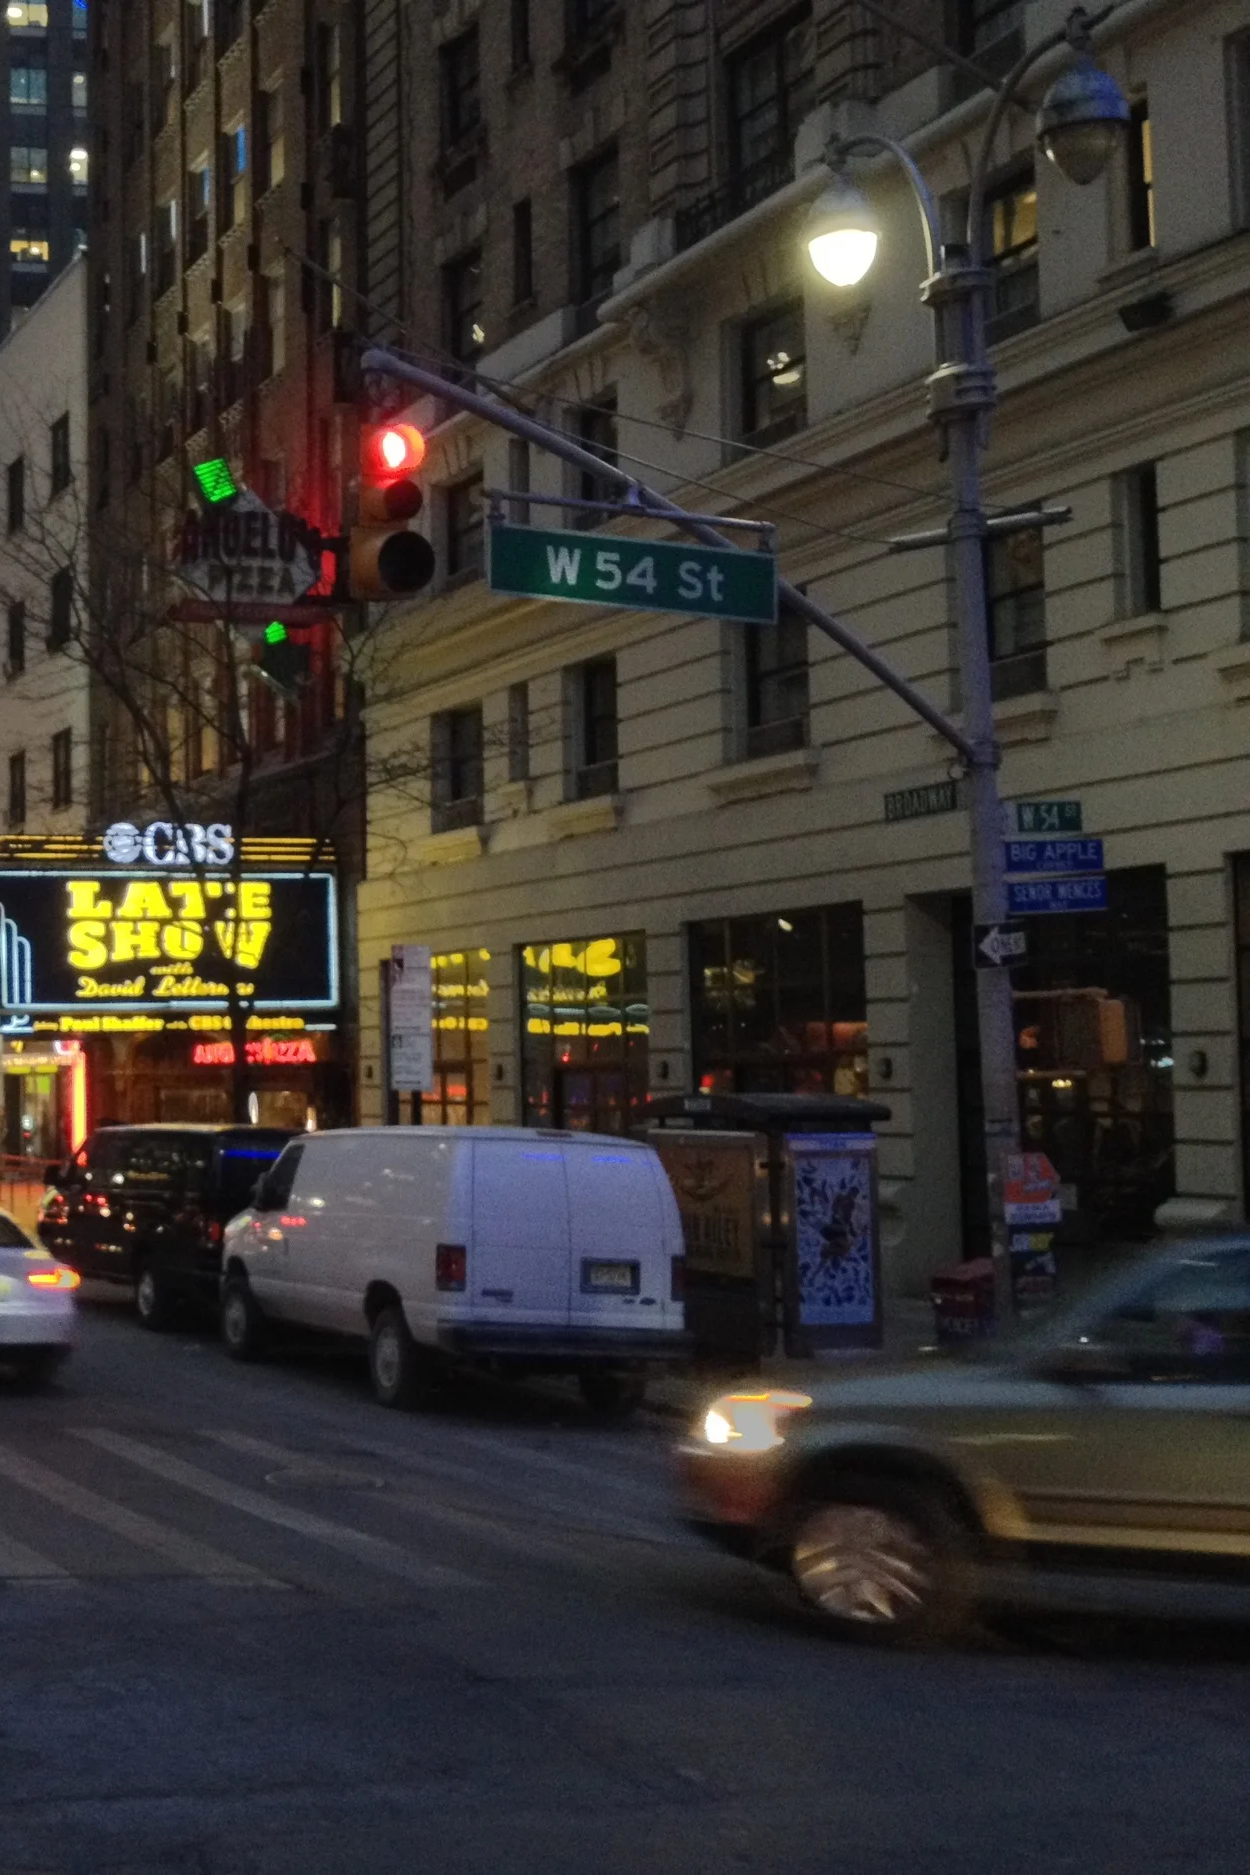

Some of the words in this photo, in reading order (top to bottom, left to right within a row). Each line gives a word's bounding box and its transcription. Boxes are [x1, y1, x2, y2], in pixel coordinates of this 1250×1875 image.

[547, 545, 581, 585] W
[595, 551, 657, 594] 54
[678, 560, 724, 601] St
[1021, 805, 1035, 827] W
[1040, 803, 1061, 829] 54
[143, 822, 235, 864] CBS
[1010, 842, 1036, 861] BIG
[1044, 840, 1099, 859] APPLE
[66, 880, 272, 919] LATE
[67, 919, 271, 970] SHOW
[75, 976, 146, 998] David
[152, 975, 255, 998] Lettermn
[59, 1015, 100, 1032] Paul
